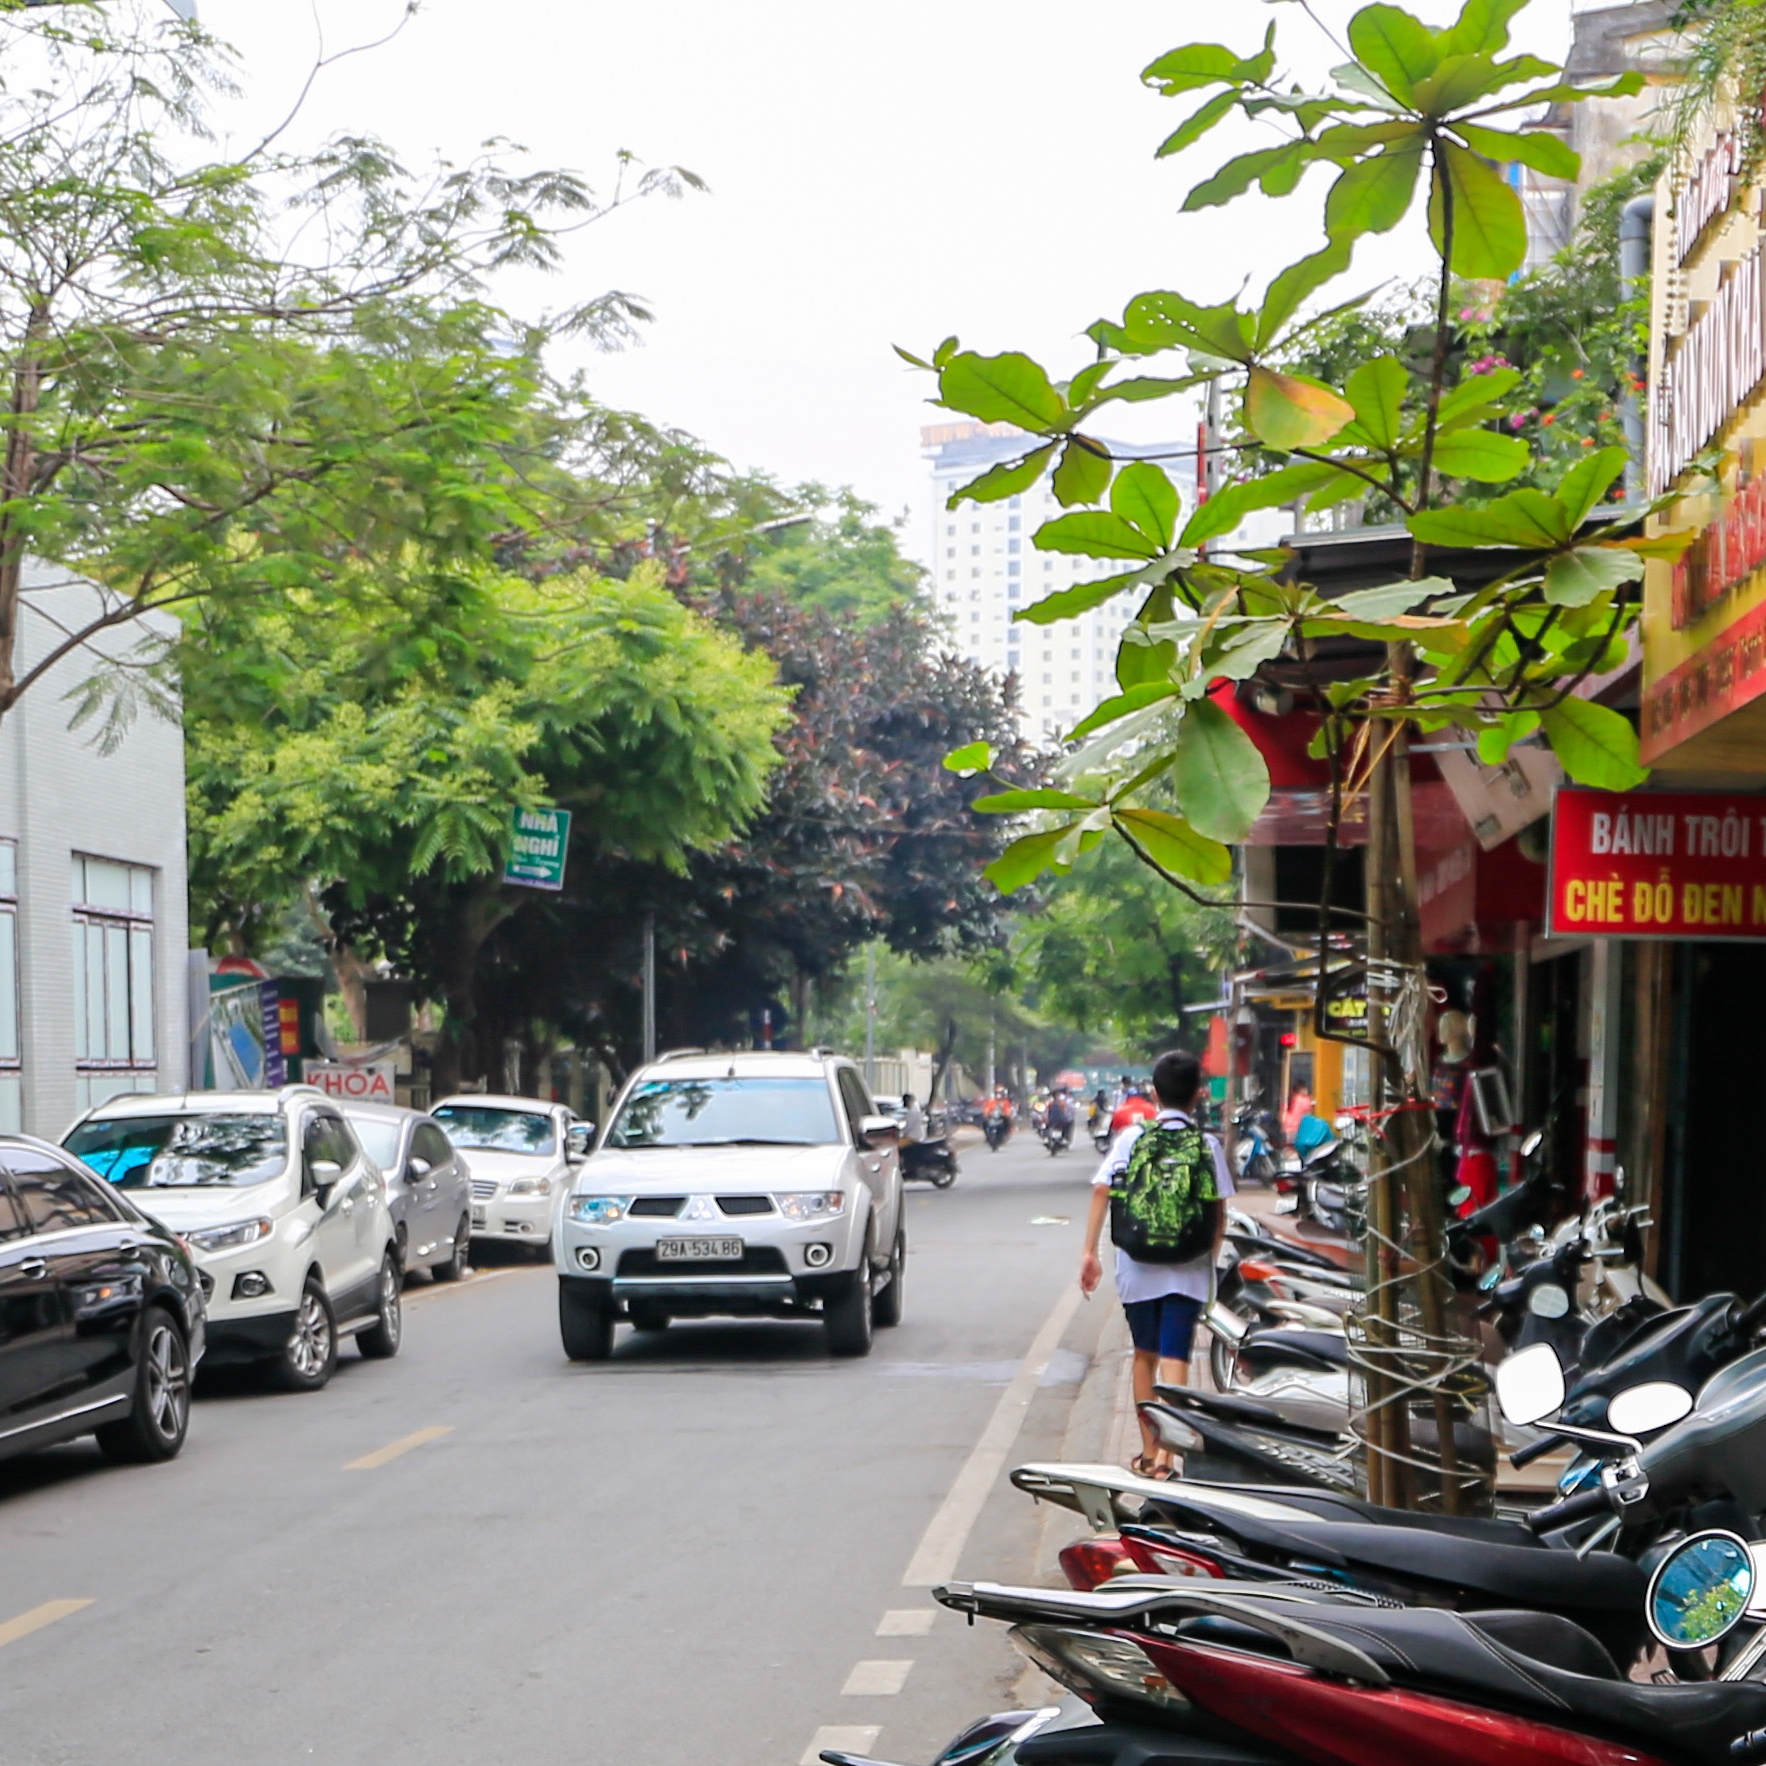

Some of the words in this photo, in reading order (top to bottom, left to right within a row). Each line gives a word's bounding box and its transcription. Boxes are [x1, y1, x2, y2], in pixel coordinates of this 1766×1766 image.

[1591, 811, 1674, 858] BÁNH
[1685, 812, 1750, 858] TRÔI
[1565, 872, 1623, 924] CHÈ
[1633, 867, 1675, 925] ĐỖ
[1684, 882, 1743, 926] ĐEN
